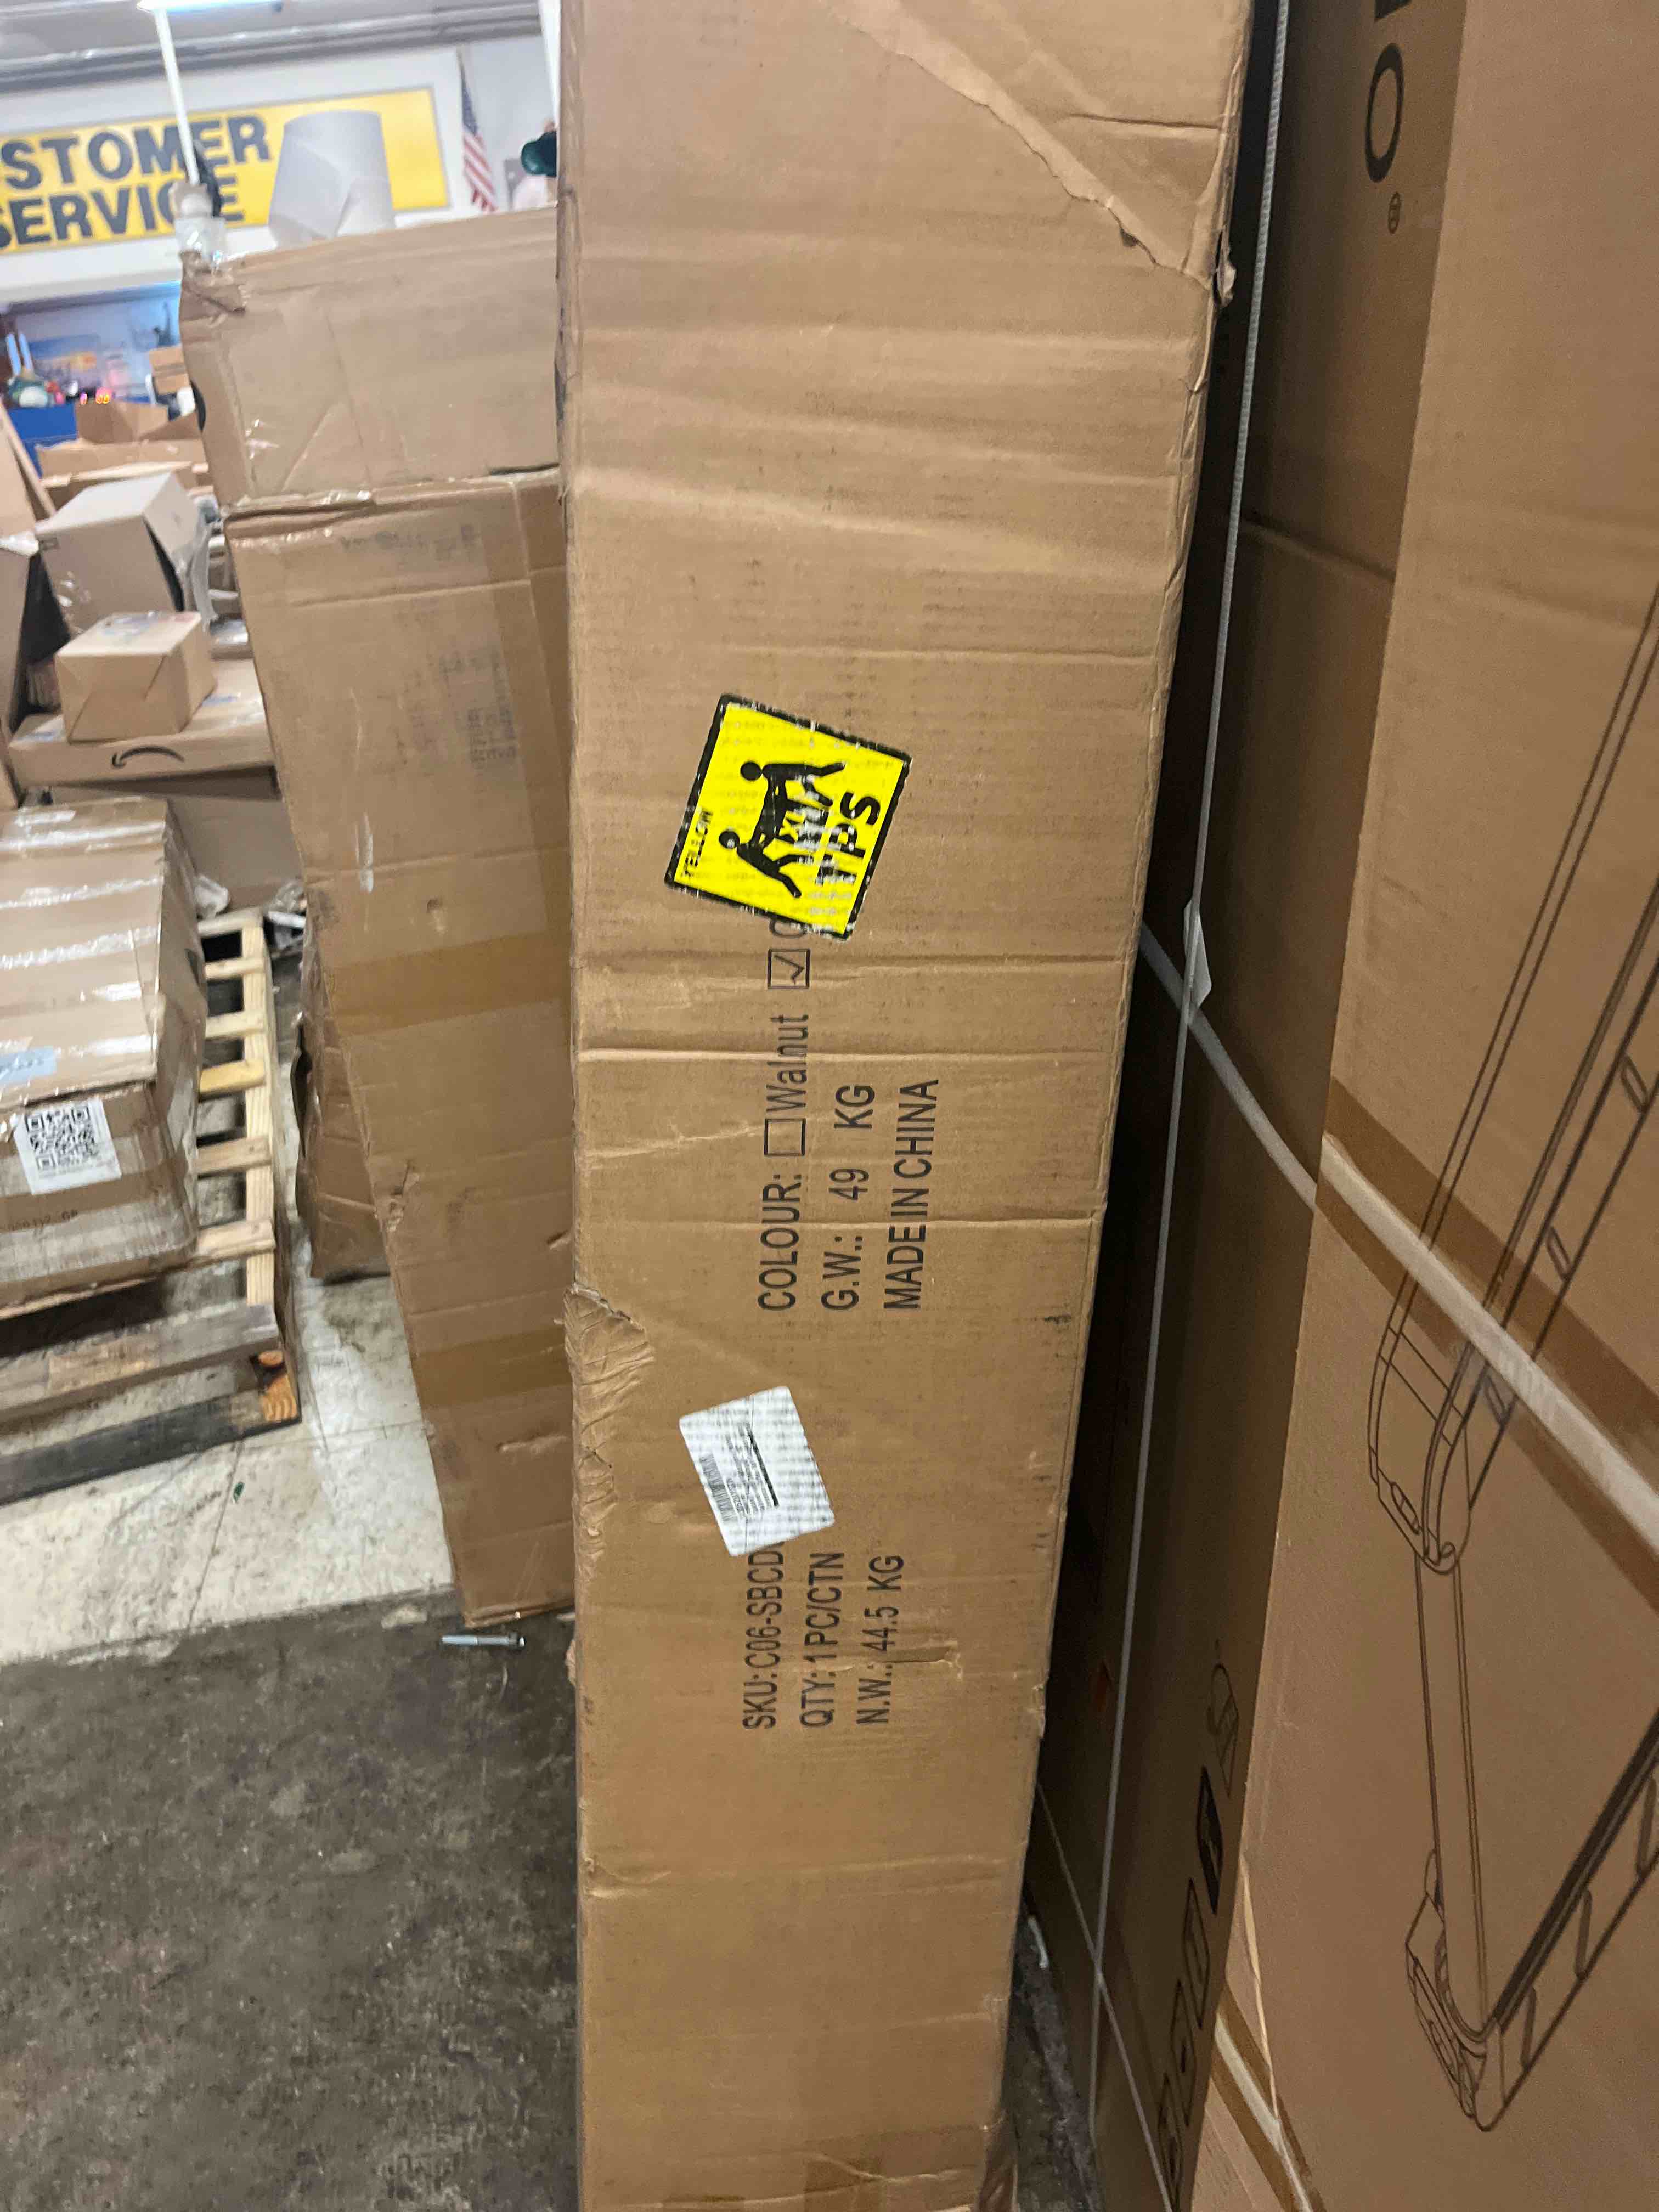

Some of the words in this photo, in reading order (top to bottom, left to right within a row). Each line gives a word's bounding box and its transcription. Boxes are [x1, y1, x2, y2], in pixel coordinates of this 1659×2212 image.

[766, 1014, 809, 1113] Walnut
[833, 1085, 876, 1129] KG
[893, 1079, 939, 1179] CHINA
[828, 1168, 870, 1201] 49
[890, 1188, 929, 1216] IN
[758, 1174, 802, 1311] COLOUR:
[821, 1235, 863, 1310] G.W.:
[883, 1224, 926, 1309] MADE
[866, 1555, 905, 1592] KG
[860, 1606, 899, 1652] 44.5
[856, 1664, 893, 1724] N.W.:
